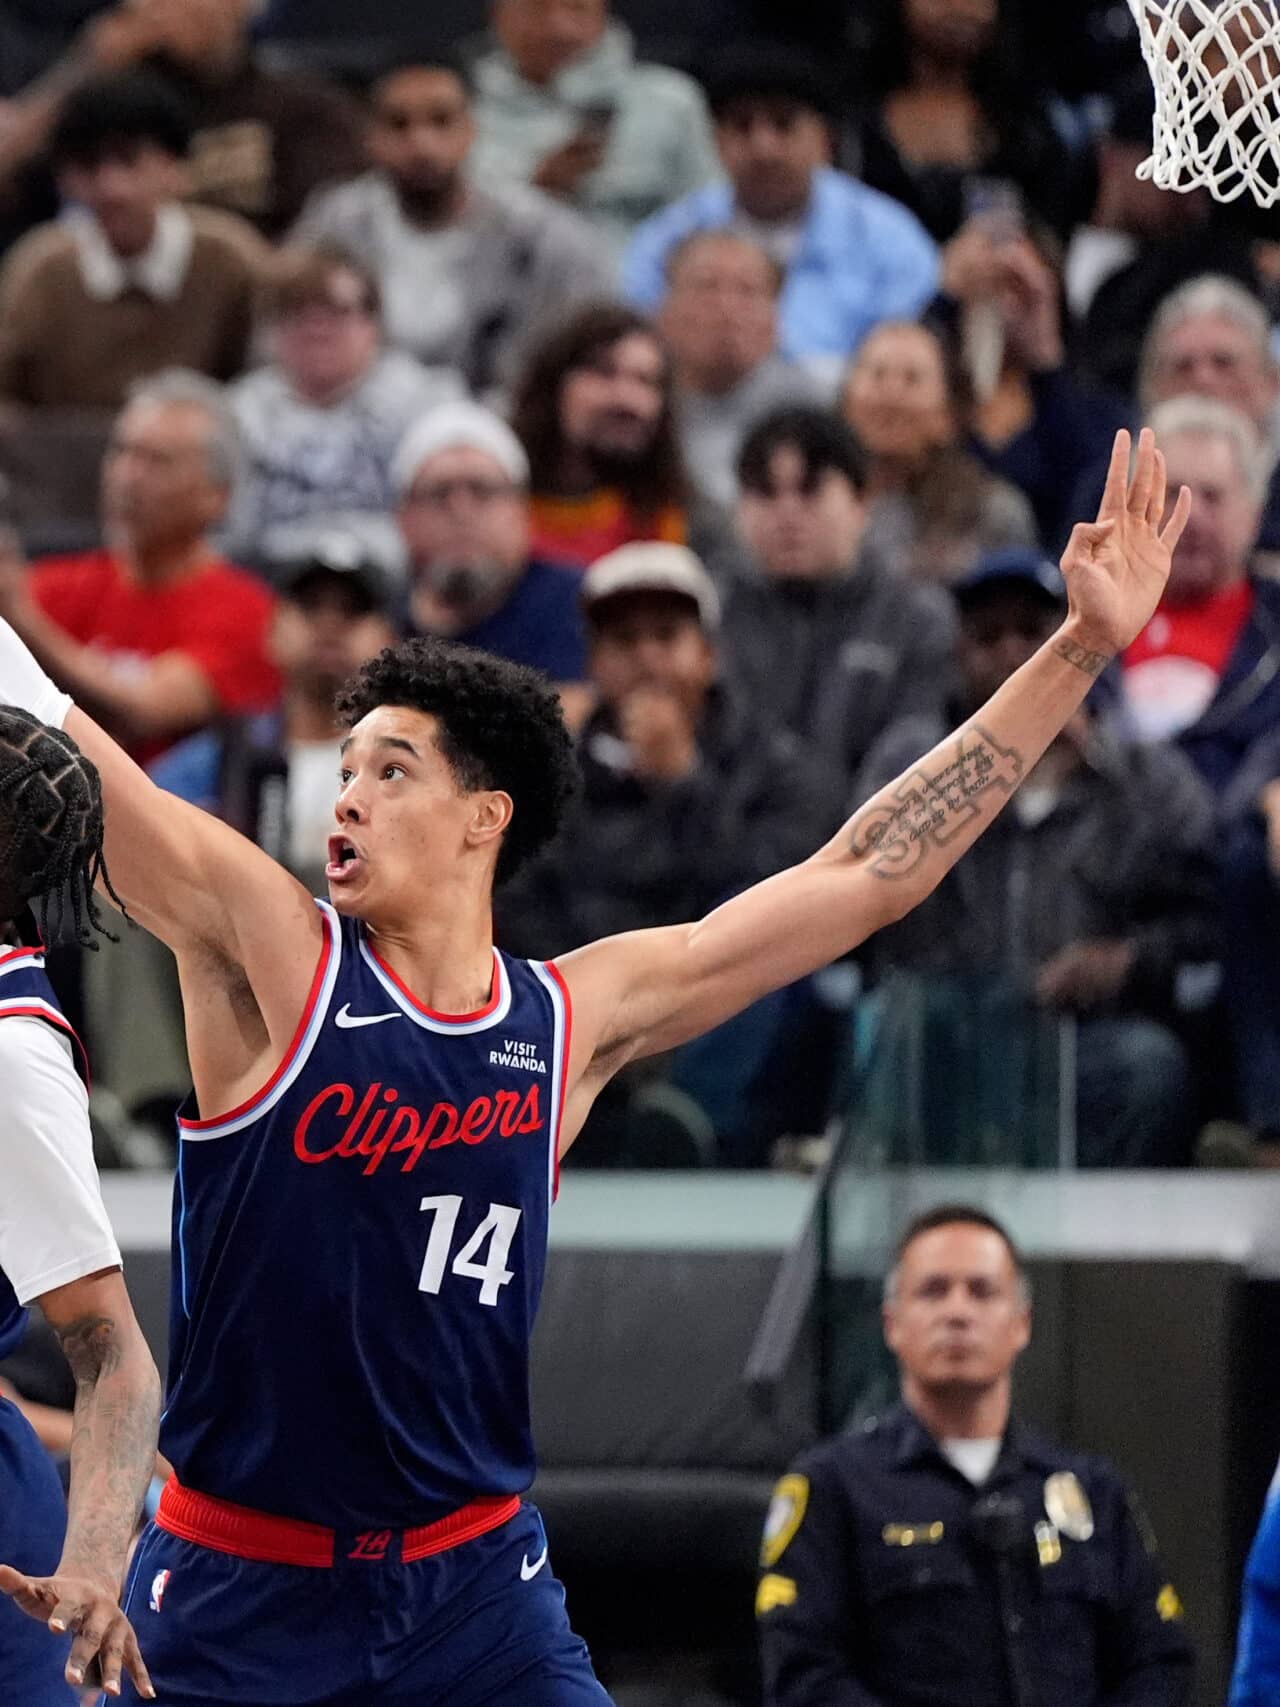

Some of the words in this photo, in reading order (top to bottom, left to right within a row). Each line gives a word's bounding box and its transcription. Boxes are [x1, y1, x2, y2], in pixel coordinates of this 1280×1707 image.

[489, 1051, 547, 1074] RWANDA
[503, 1039, 537, 1057] VISIT
[293, 1081, 546, 1176] Clippers
[417, 1194, 523, 1307] 14
